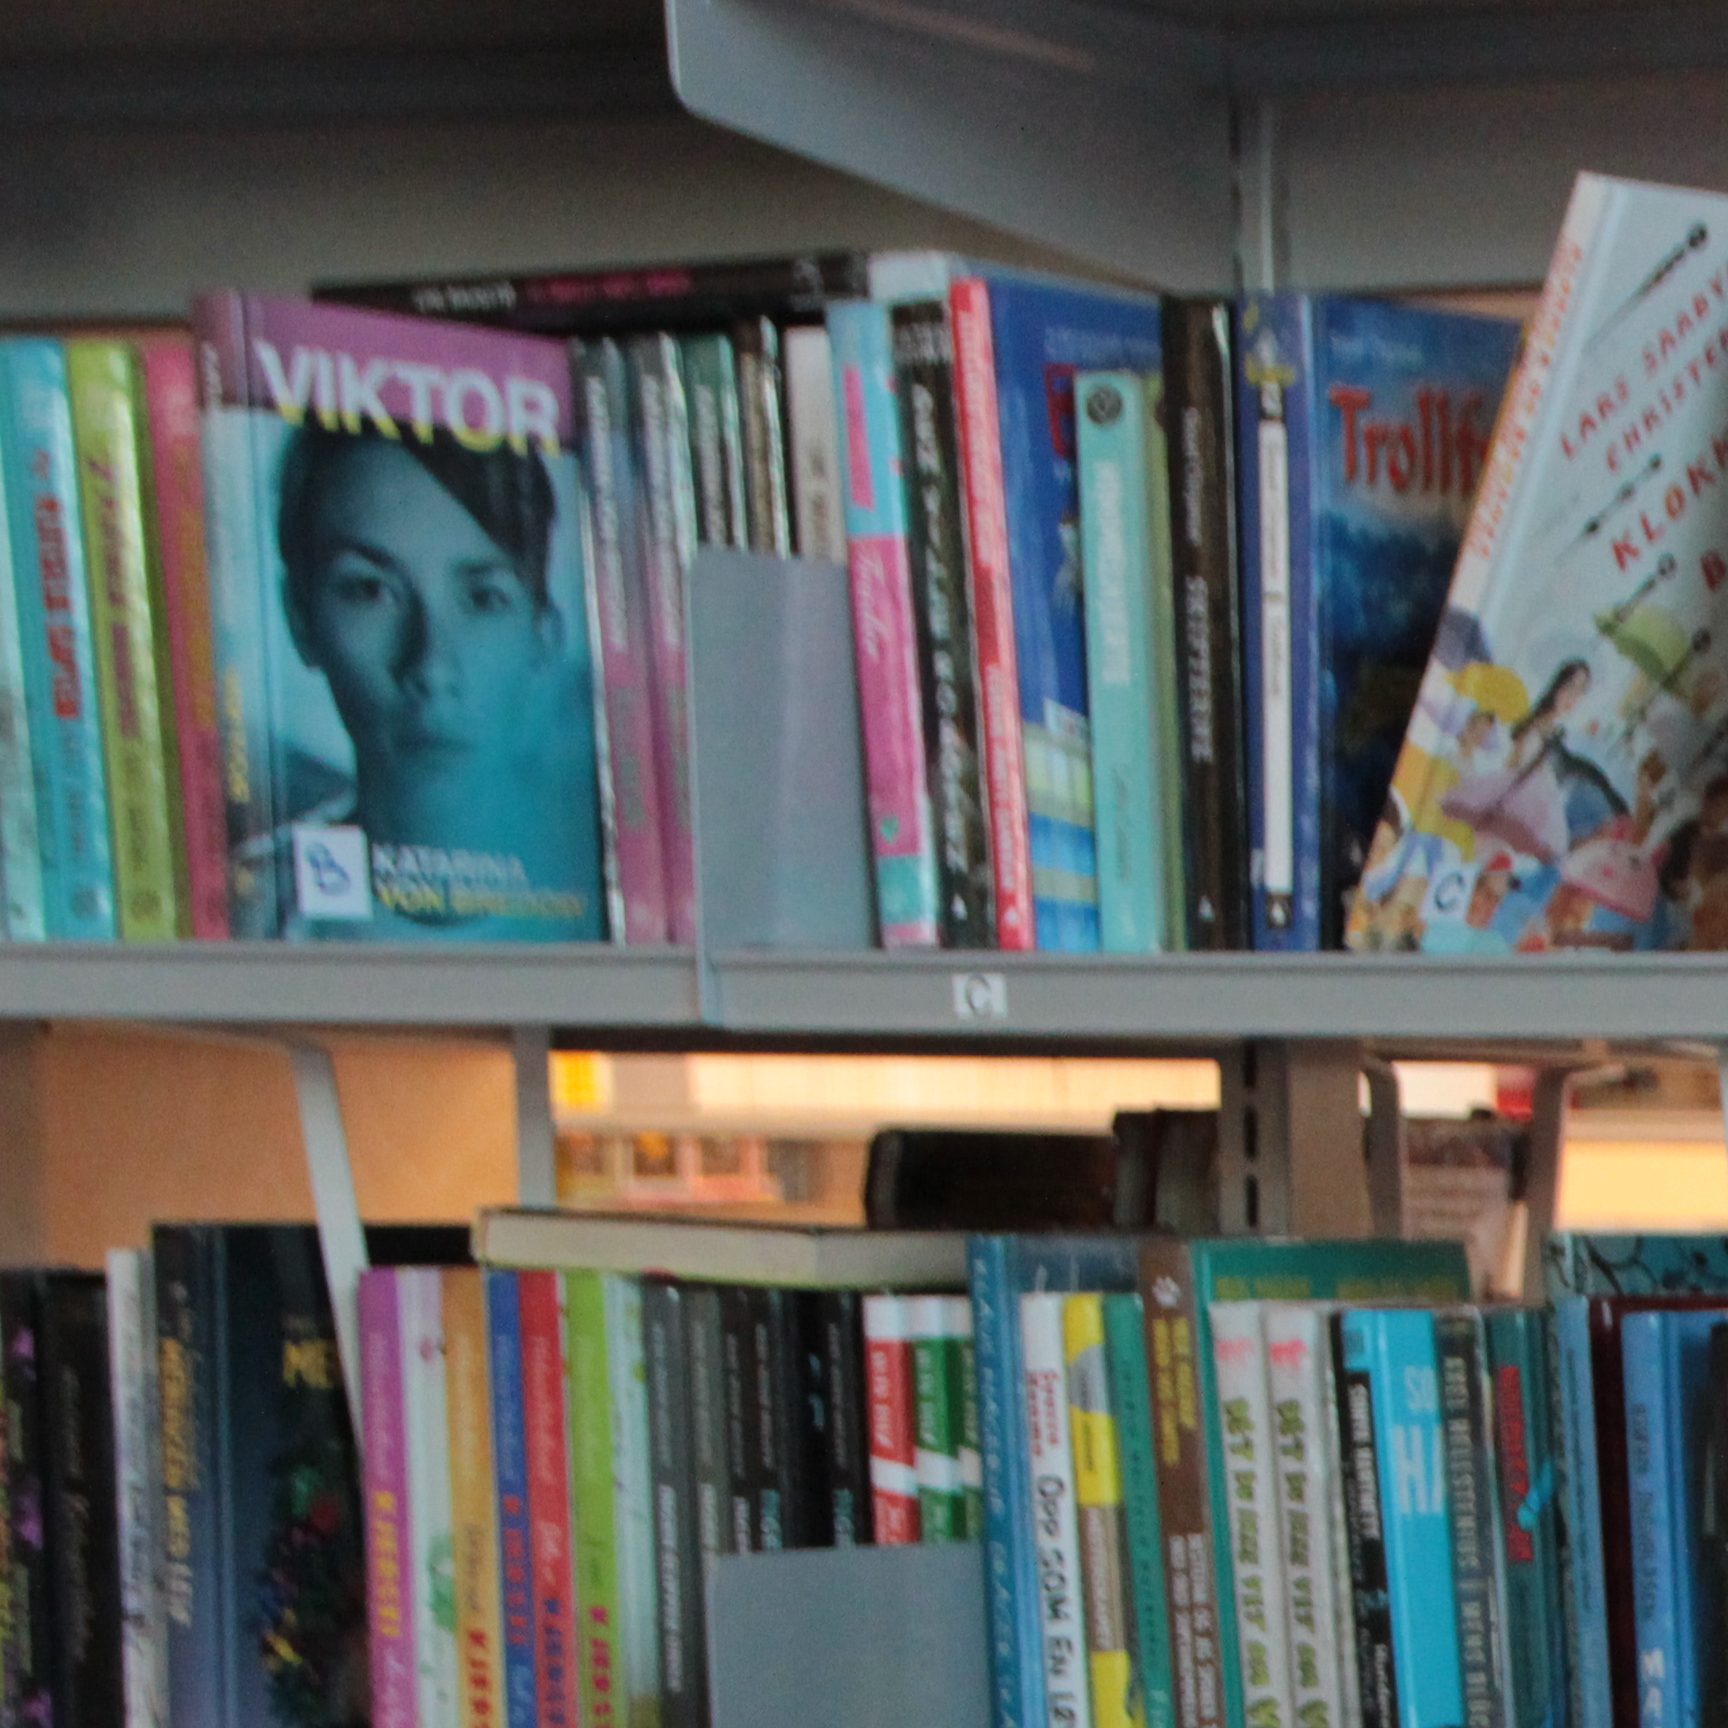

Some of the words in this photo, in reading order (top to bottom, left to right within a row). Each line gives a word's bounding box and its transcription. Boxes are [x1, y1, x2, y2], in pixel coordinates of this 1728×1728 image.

[254, 338, 562, 458] VIKTOR
[1558, 373, 1632, 460] LARS
[965, 973, 992, 1017] C
